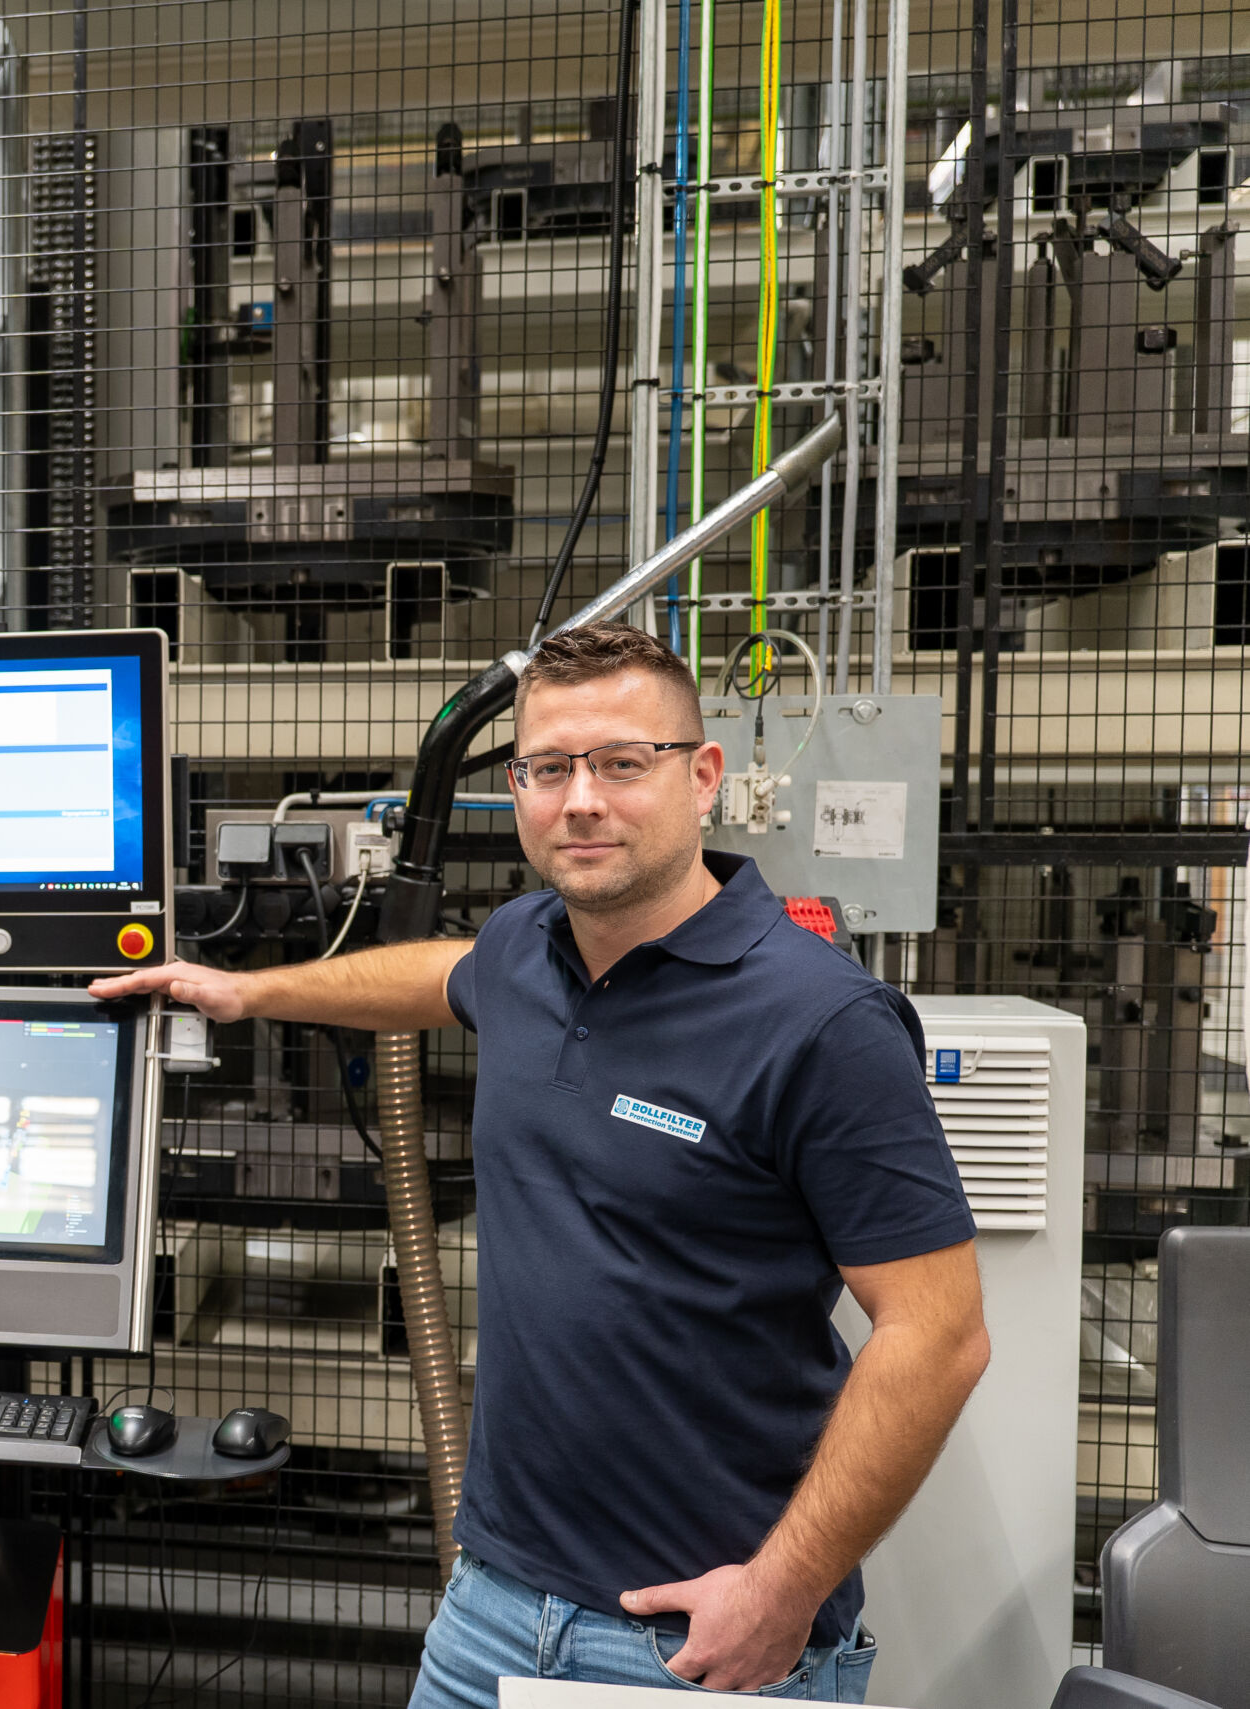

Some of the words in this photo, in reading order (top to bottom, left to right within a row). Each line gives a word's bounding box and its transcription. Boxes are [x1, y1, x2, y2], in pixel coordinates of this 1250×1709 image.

[628, 1112, 666, 1128] Protection
[667, 1124, 699, 1139] Systems
[631, 1102, 703, 1132] BOLLFILTER
